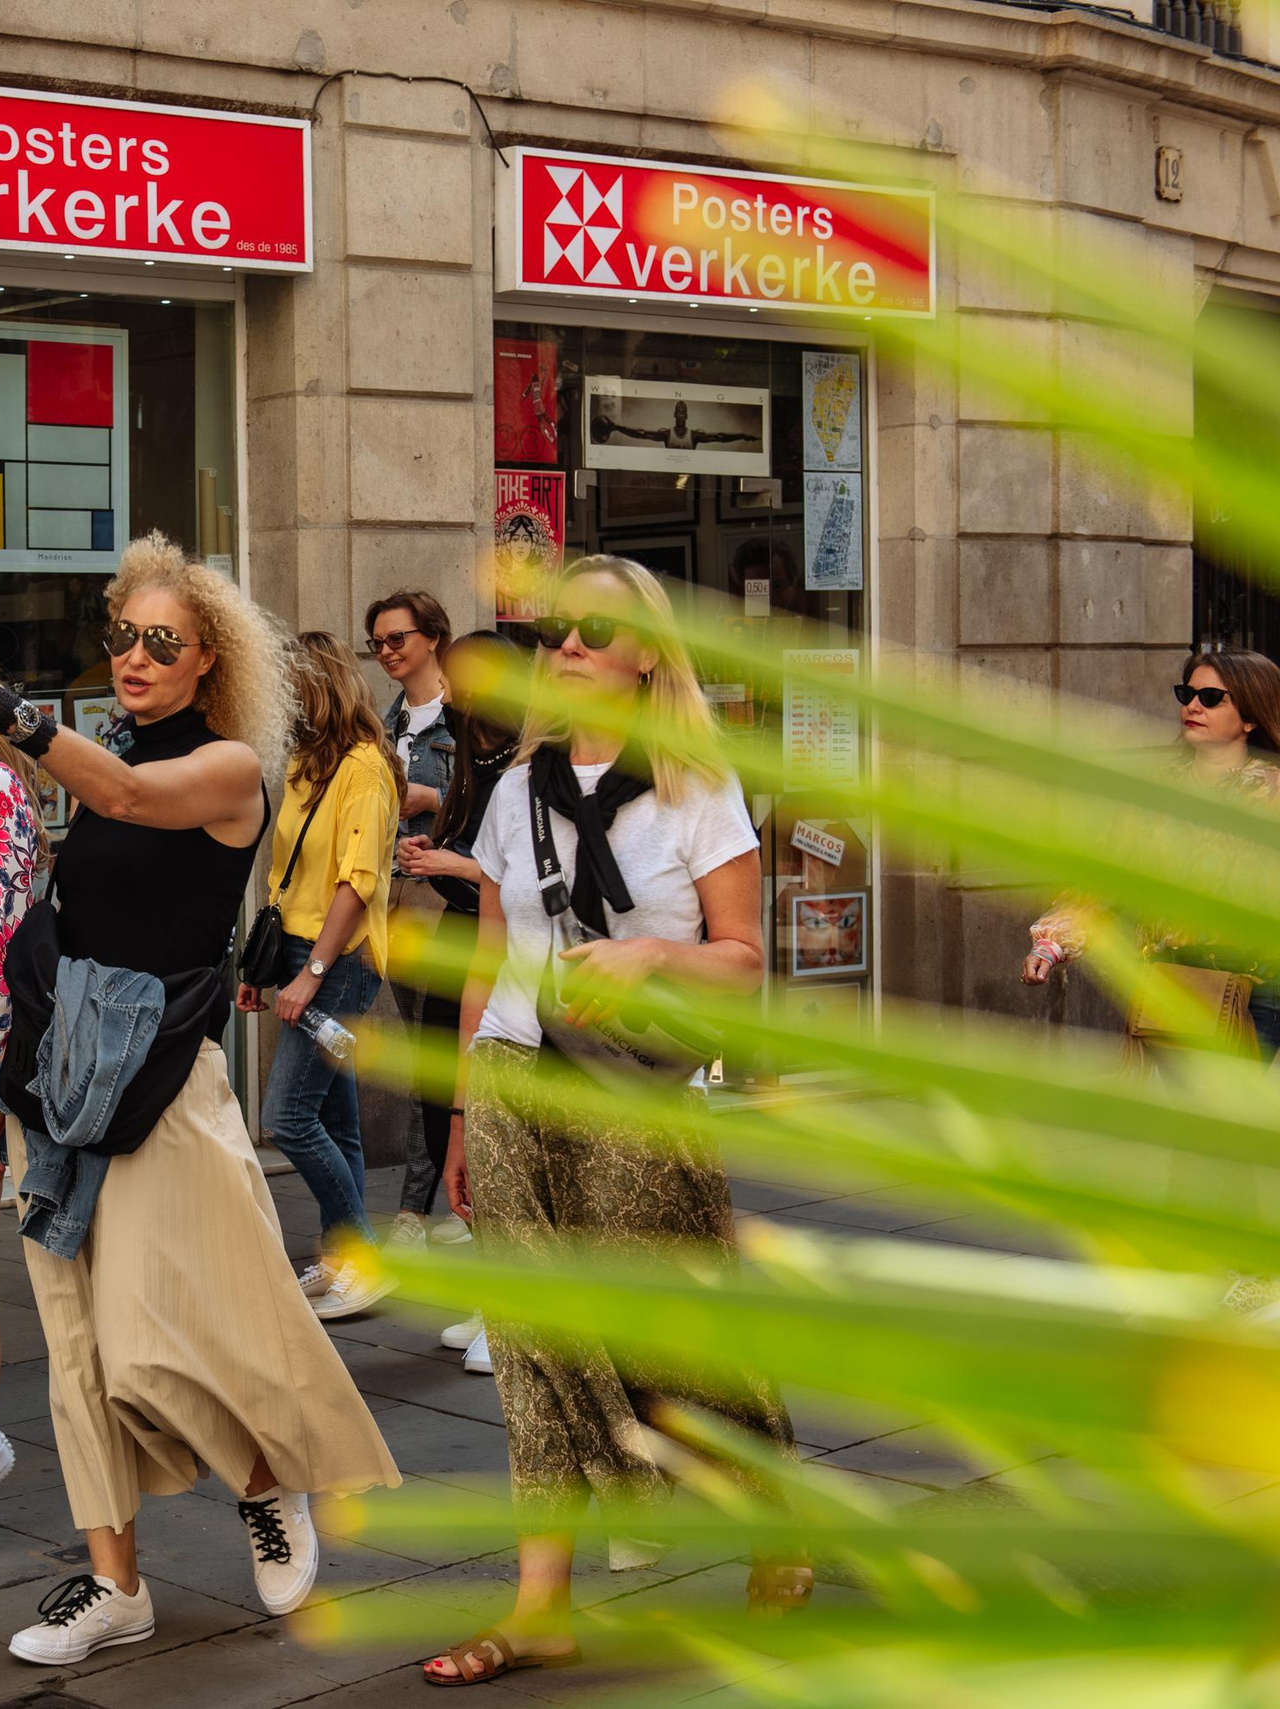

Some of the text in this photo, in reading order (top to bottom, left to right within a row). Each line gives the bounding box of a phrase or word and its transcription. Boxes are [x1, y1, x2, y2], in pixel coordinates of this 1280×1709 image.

[1164, 157, 1180, 189] 12
[672, 182, 834, 241] Posters
[236, 239, 298, 255] des de 1985
[625, 236, 877, 306] verkerke
[531, 476, 562, 533] ART
[38, 553, 72, 562] Mondrian
[791, 653, 854, 664] MARCOS
[796, 825, 842, 854] MARCOS
